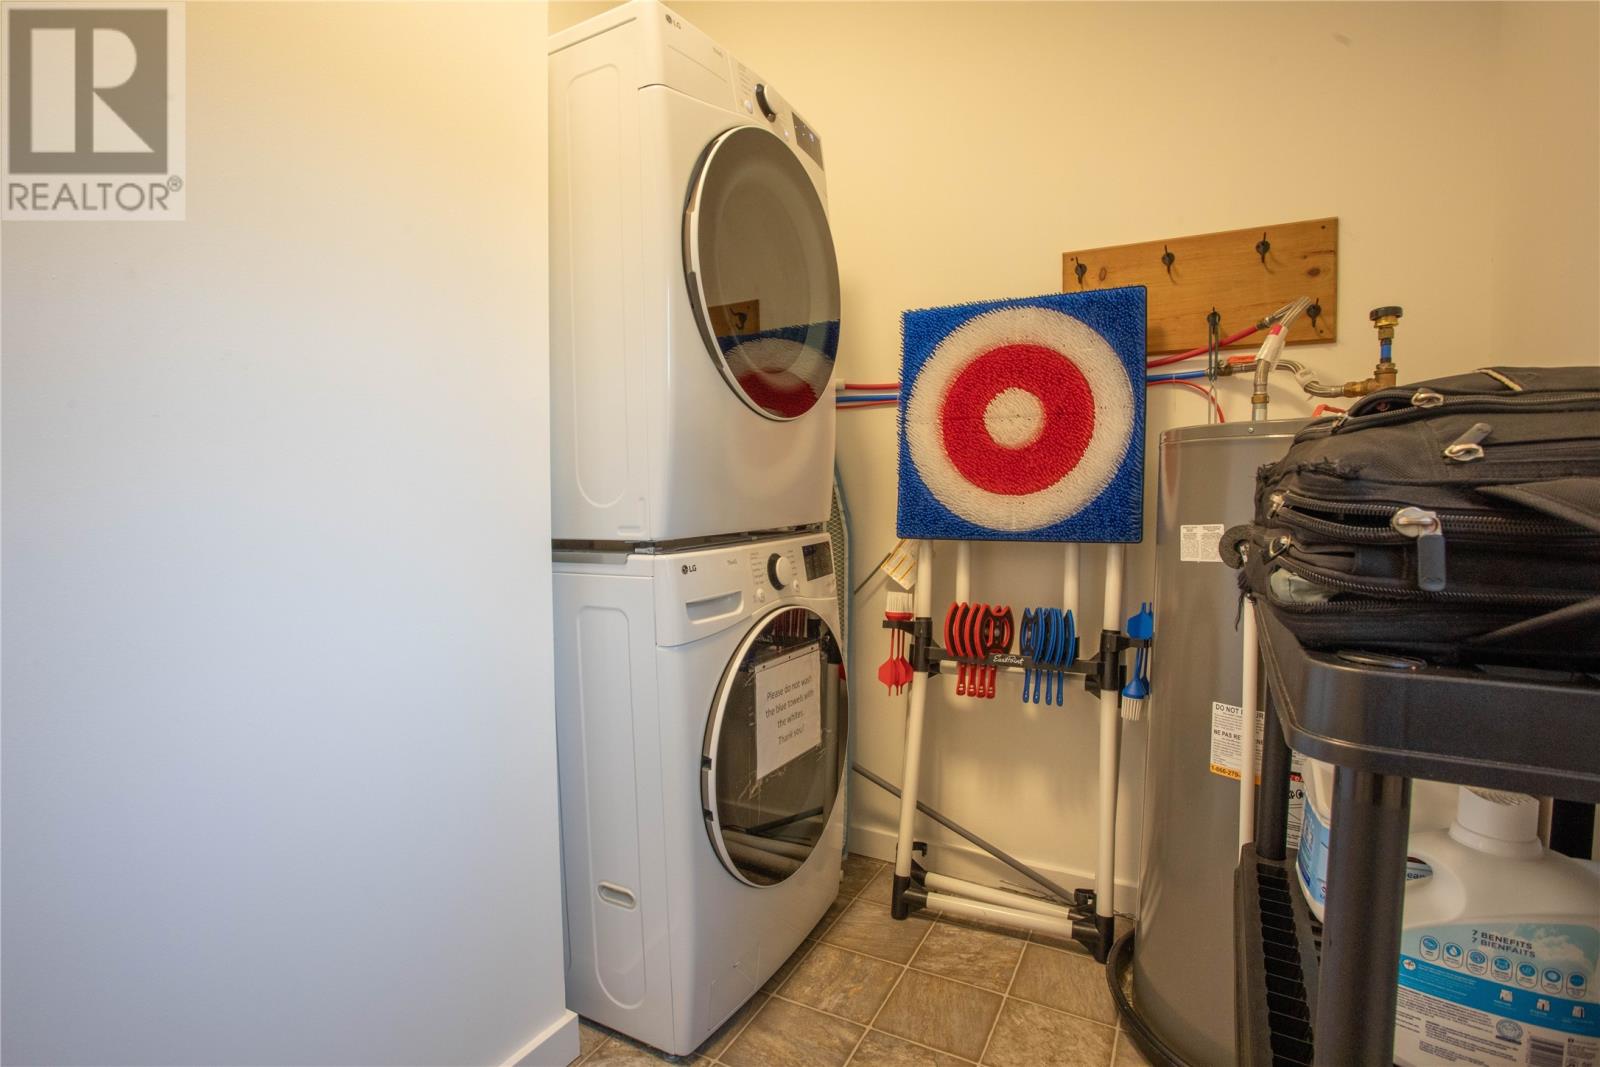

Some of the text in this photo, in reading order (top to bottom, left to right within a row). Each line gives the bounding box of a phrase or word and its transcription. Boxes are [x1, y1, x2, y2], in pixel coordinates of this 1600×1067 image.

[767, 689, 784, 700] Please
[784, 684, 791, 694] do
[792, 680, 800, 689] not
[765, 707, 775, 719] the
[776, 703, 787, 714] blue
[1226, 706, 1240, 714] NOT
[777, 718, 787, 729] the
[1222, 730, 1232, 739] PAS
[1480, 931, 1533, 950] BENEFITS
[1480, 939, 1536, 958] BIENFAITS
